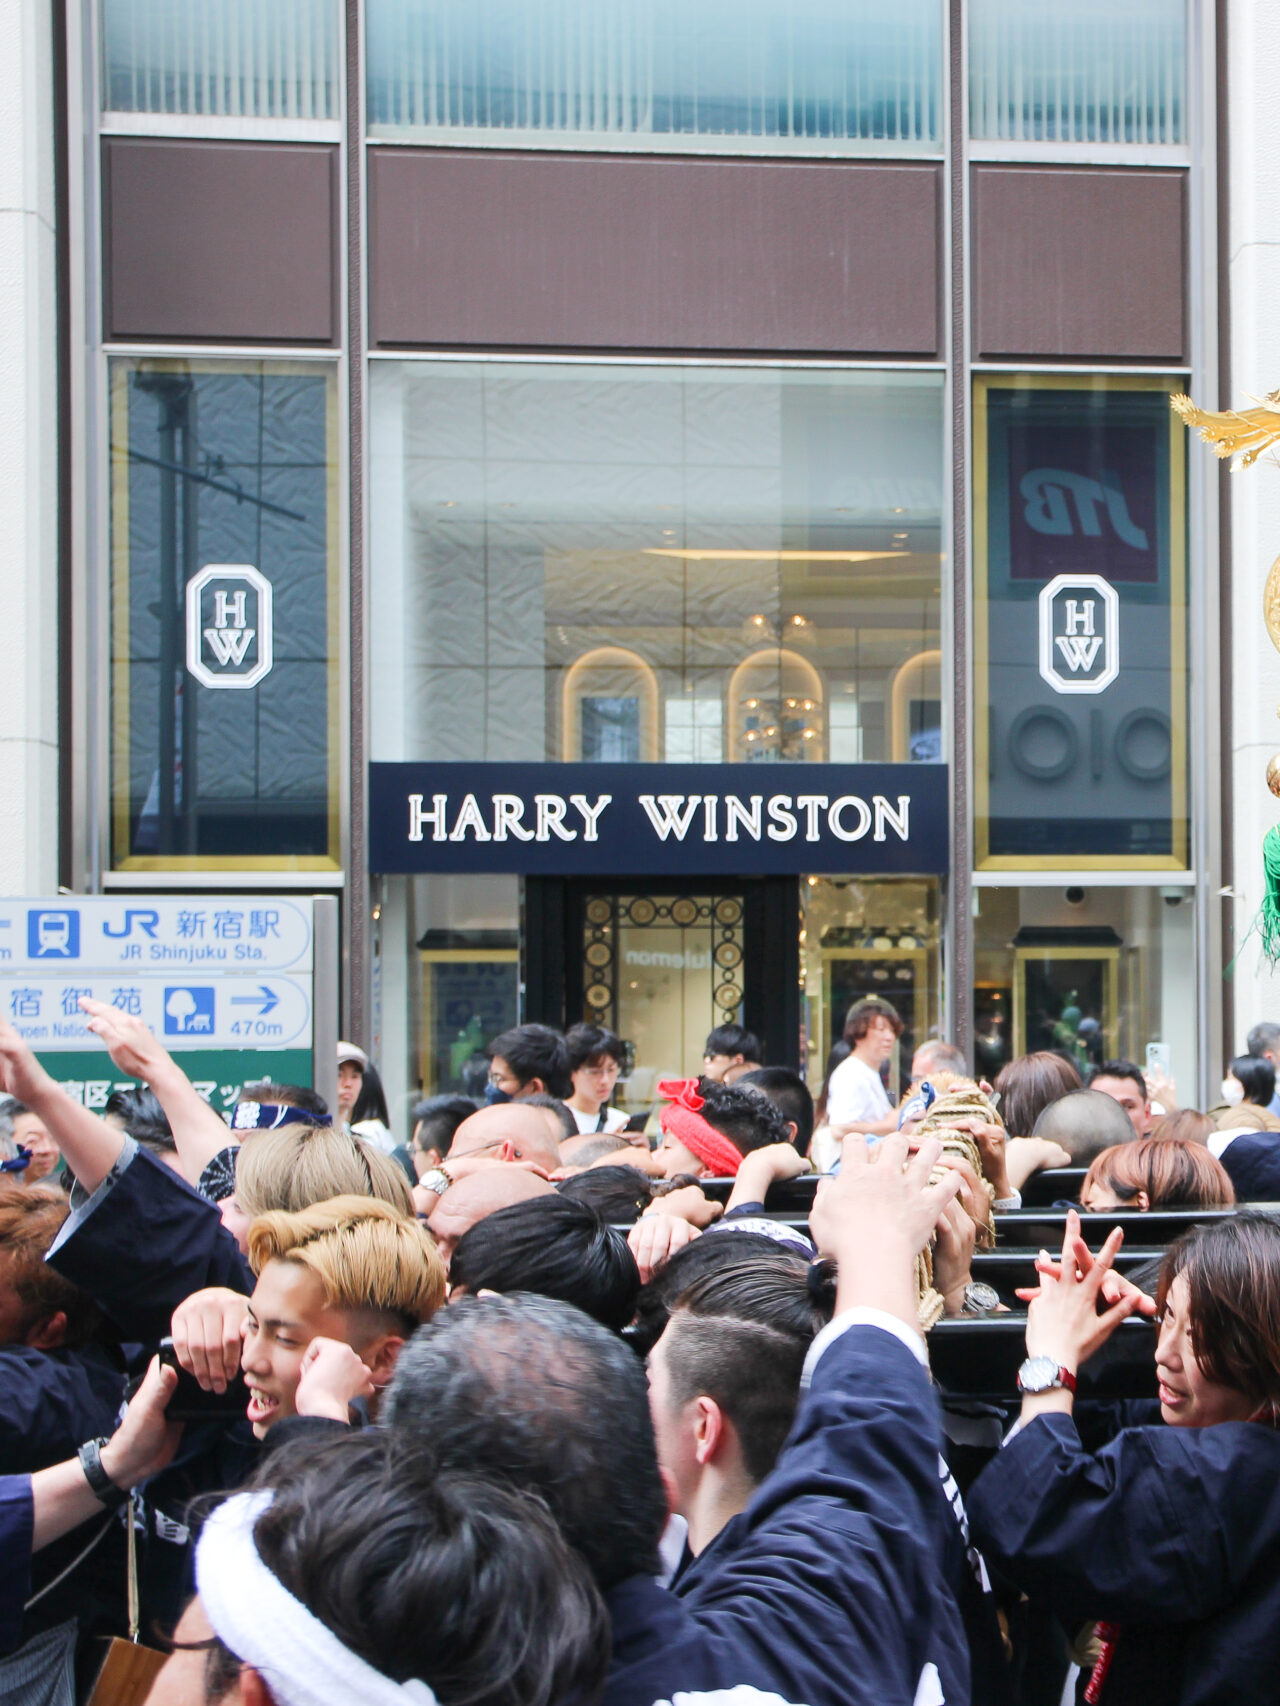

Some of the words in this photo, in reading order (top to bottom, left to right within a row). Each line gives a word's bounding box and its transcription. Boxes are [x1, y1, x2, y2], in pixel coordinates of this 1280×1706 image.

[408, 794, 612, 842] HARRY
[639, 795, 911, 842] WINSTON
[103, 910, 159, 938] JR
[177, 910, 281, 939] 新宿駅
[120, 945, 142, 960] JR
[150, 944, 227, 962] Shinjuku
[235, 944, 267, 960] Sta.
[11, 1022, 48, 1039] yoen
[231, 1021, 283, 1035] 470m
